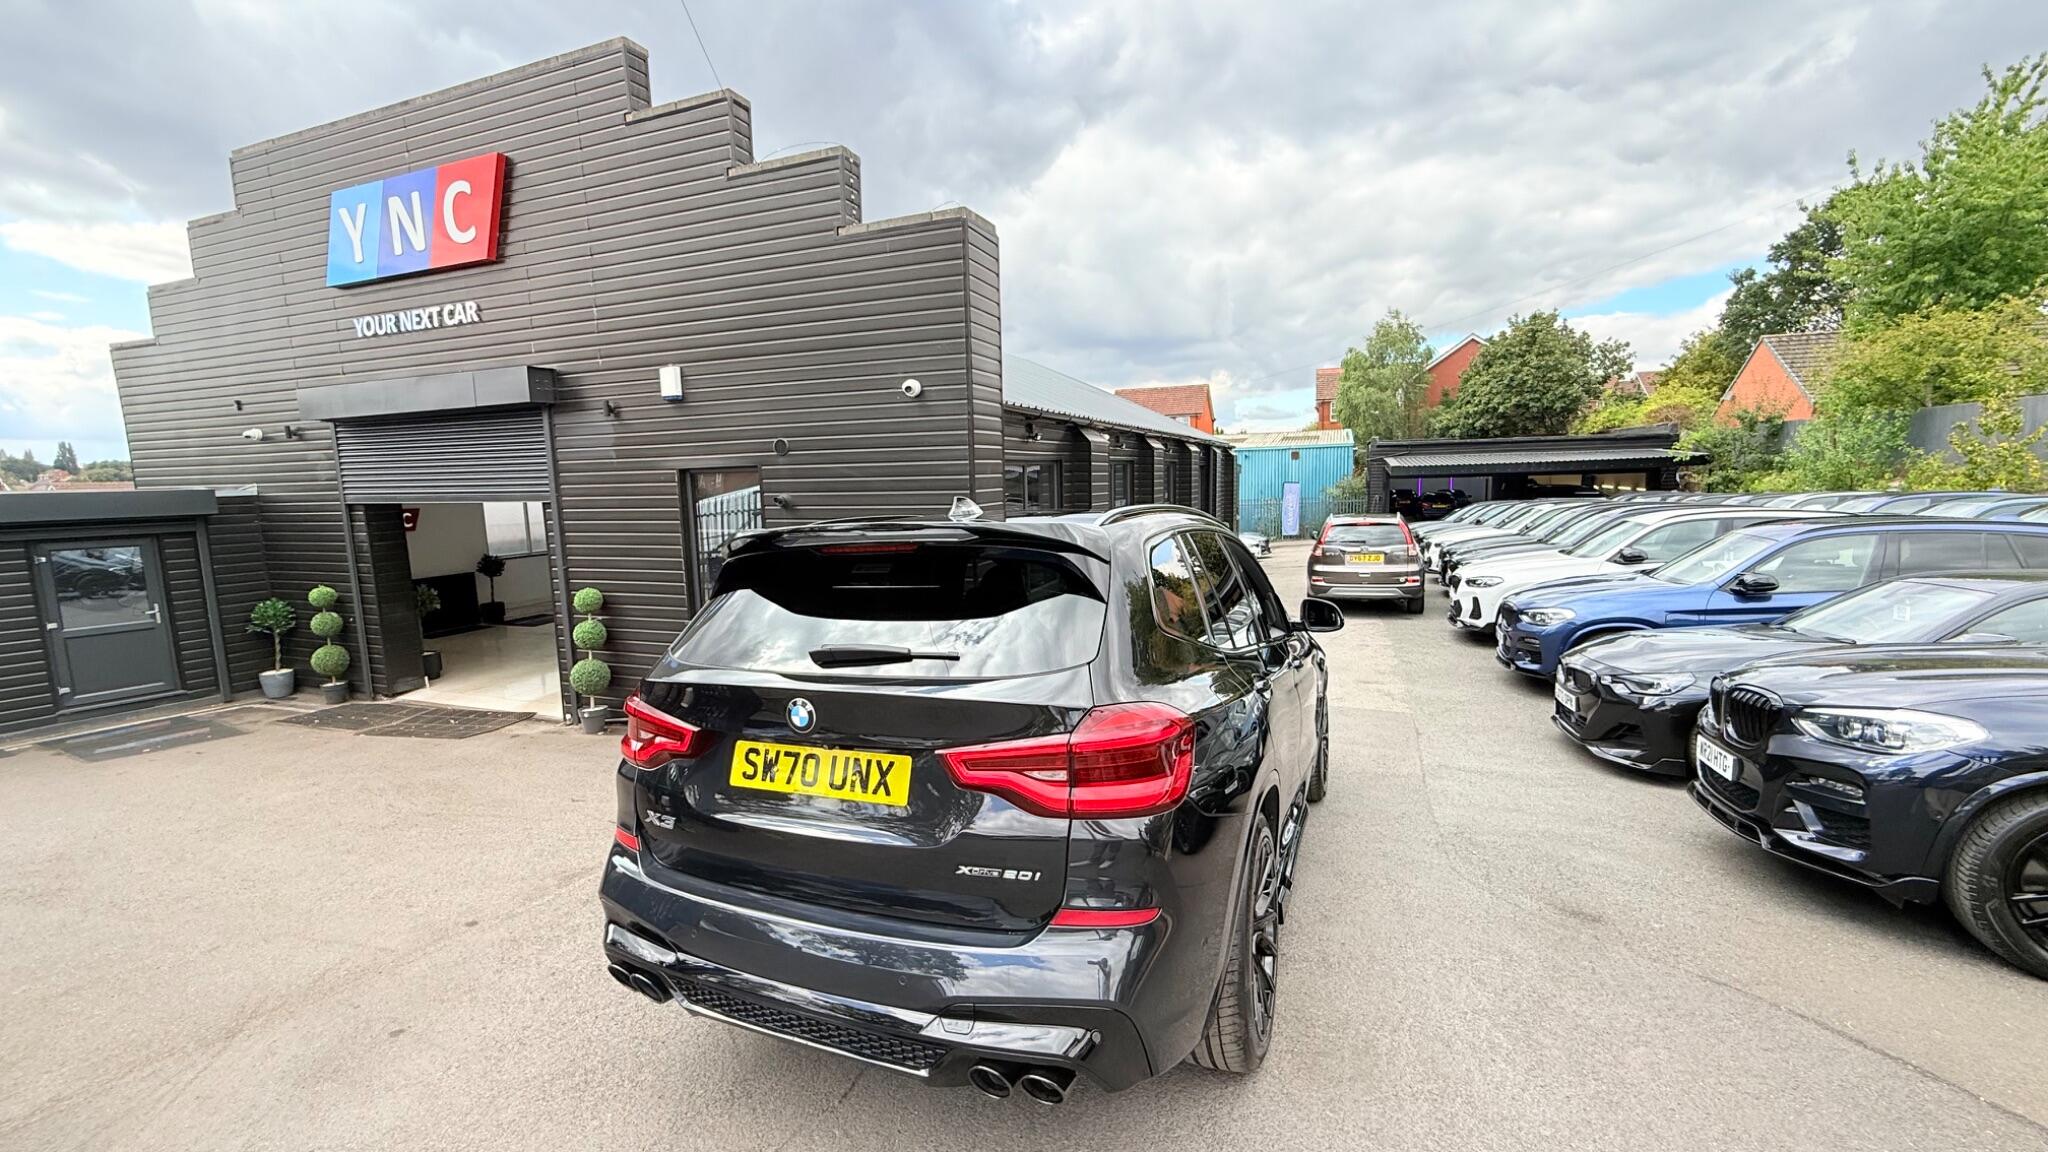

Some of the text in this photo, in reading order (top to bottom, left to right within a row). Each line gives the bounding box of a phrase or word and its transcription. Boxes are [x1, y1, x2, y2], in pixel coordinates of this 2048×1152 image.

[338, 180, 476, 263] YNC
[353, 300, 480, 338] YOUR NEXT CAR
[742, 747, 895, 797] SW70 UNX
[1713, 748, 1728, 773] HTG
[645, 809, 676, 830] X3
